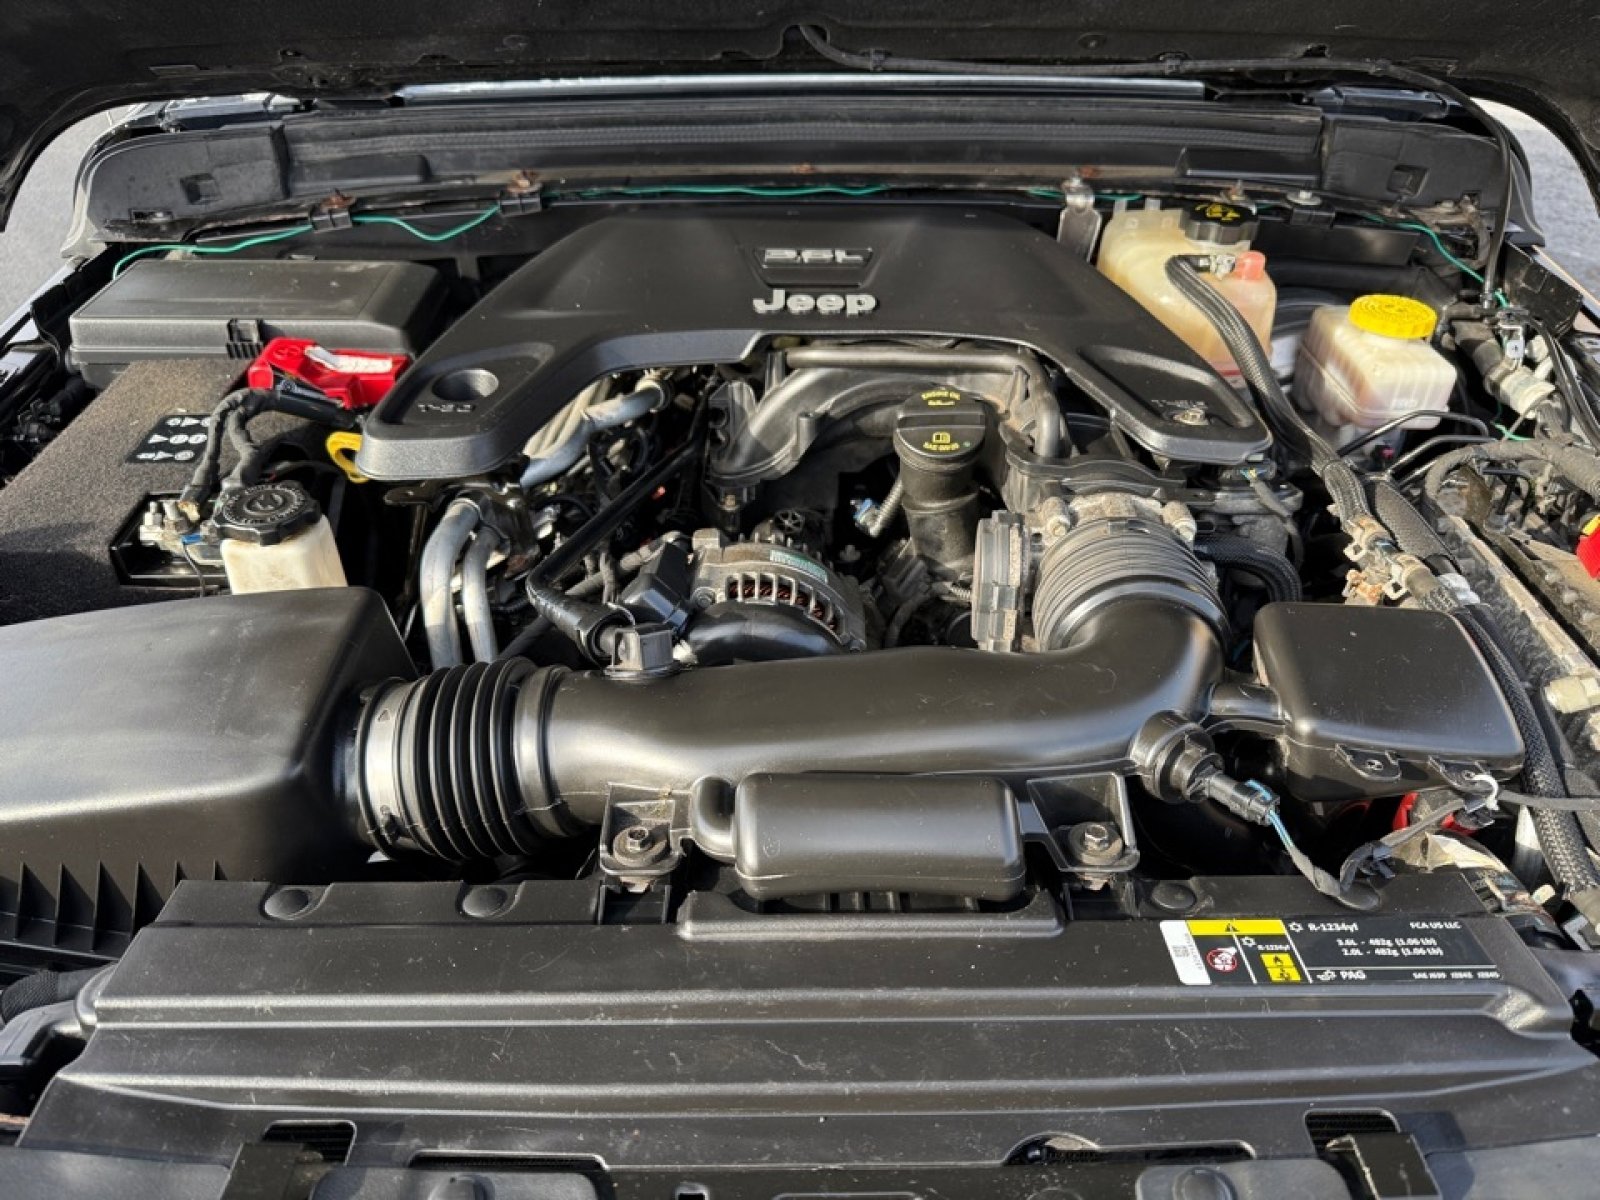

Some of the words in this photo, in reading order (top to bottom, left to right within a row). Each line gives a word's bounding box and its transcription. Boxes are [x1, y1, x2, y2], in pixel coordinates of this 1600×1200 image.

[752, 288, 877, 317] Jeep
[1307, 922, 1359, 932] R-1234yf
[1409, 921, 1430, 929] FCA
[1430, 921, 1444, 929] US
[1443, 921, 1462, 929] LLC
[1340, 970, 1366, 980] PAG
